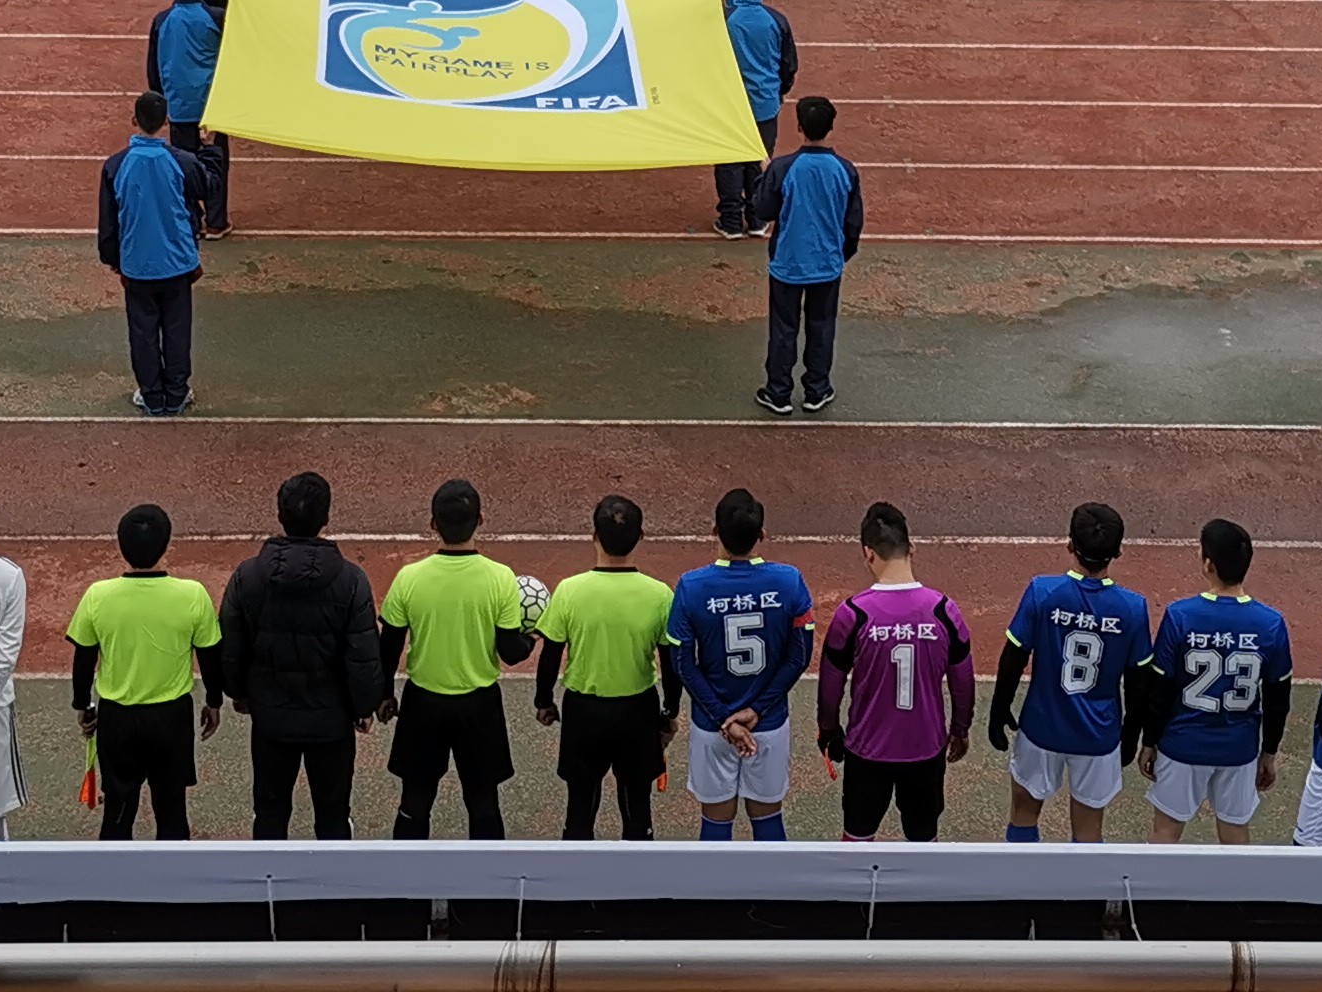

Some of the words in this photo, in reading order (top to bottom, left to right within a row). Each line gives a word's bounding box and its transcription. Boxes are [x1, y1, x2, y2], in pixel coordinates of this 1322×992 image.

[374, 43, 419, 59] MY
[429, 55, 513, 70] GAME
[524, 61, 550, 71] IS
[374, 54, 437, 73] FAIR
[445, 66, 516, 80] PLAY
[535, 94, 629, 109] FIFA
[707, 591, 782, 613] 柯桥区
[868, 622, 938, 642] 柯桥区
[1051, 607, 1122, 634] 柯桥区
[724, 611, 767, 677] 5
[1187, 631, 1259, 651] 柯桥区
[1060, 630, 1105, 695] 8
[890, 643, 916, 711] 1
[1182, 649, 1263, 713] 23
